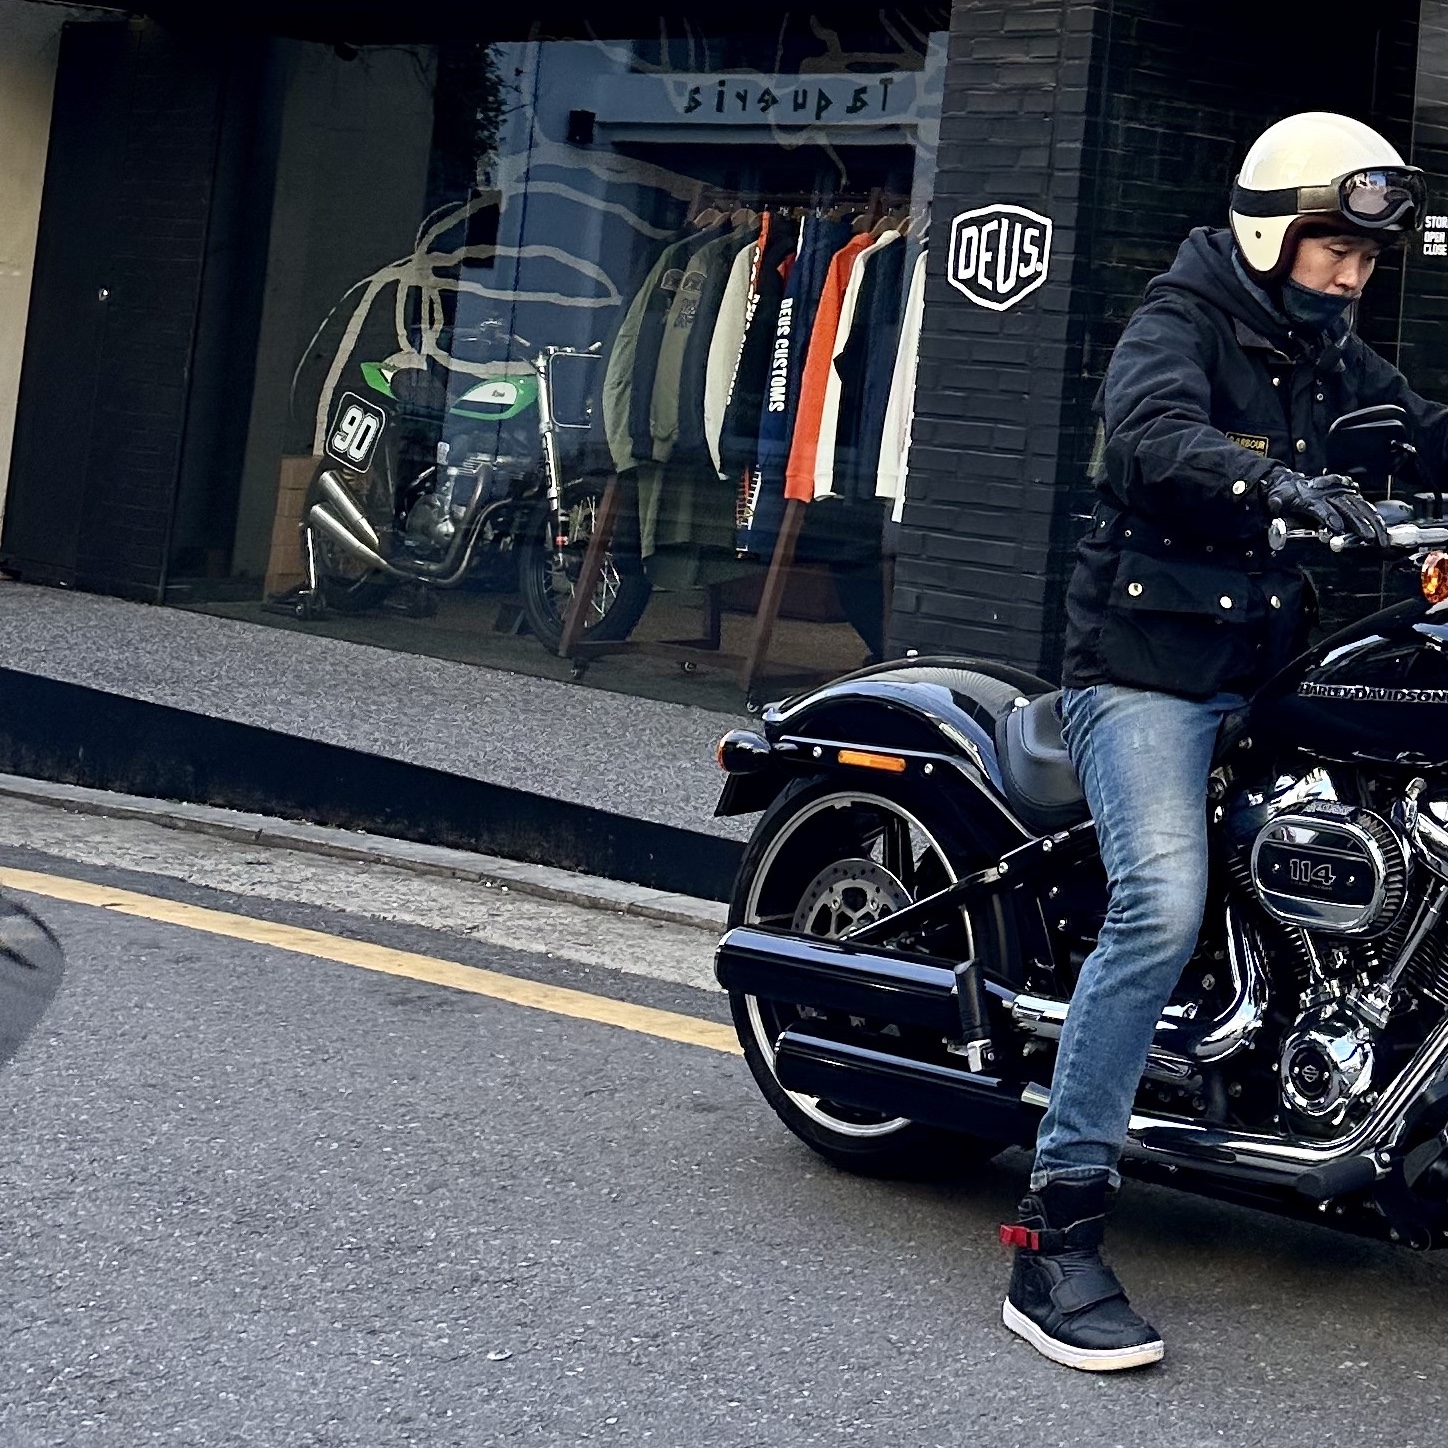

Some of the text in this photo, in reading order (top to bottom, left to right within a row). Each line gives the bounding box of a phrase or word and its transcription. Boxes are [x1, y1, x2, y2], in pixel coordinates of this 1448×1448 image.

[956, 217, 1039, 293] DEUS
[1423, 244, 1447, 256] CLOSE
[1424, 231, 1445, 243] OPEN
[768, 297, 794, 413] DEUS CUSTOMS
[331, 404, 380, 463] 90
[1289, 858, 1337, 886] 114
